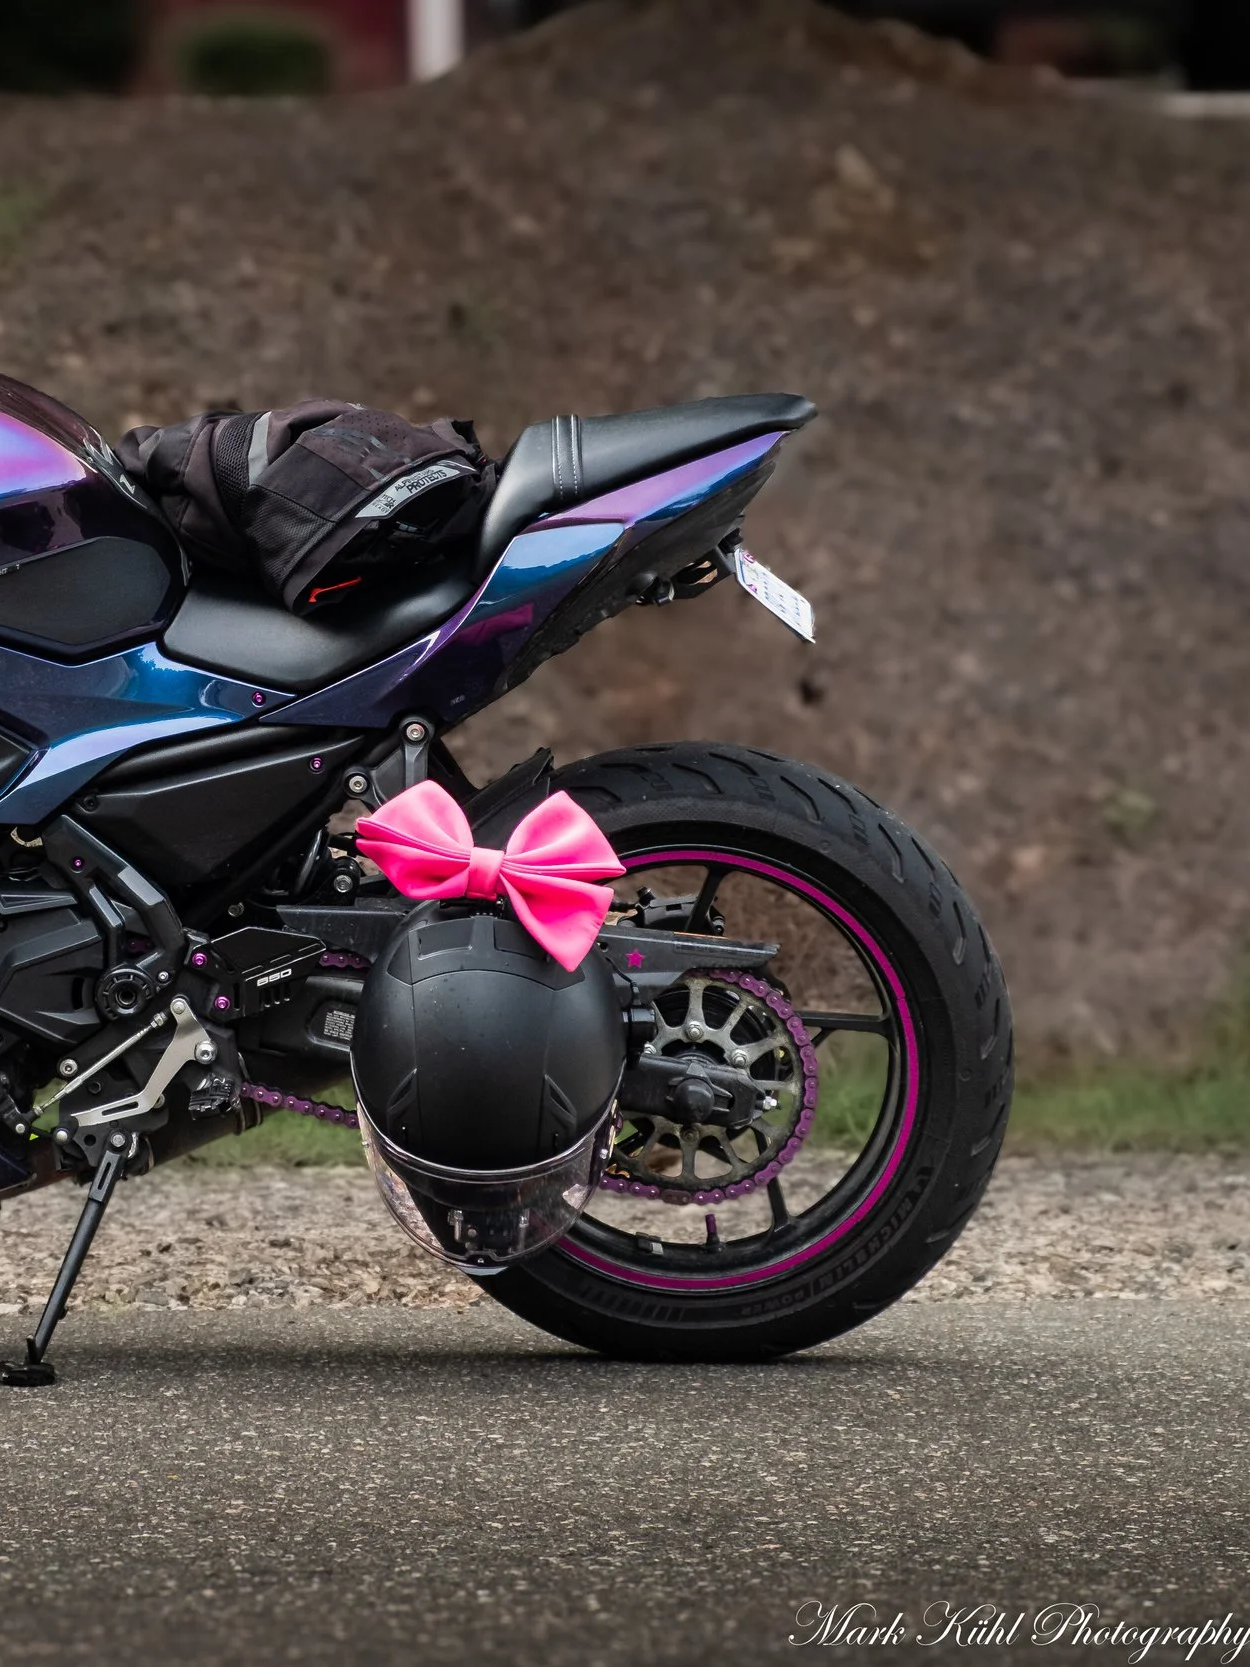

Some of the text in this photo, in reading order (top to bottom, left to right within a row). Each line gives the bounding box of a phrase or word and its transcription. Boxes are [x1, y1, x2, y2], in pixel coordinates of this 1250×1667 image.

[406, 469, 448, 494] PROTECTS
[741, 1196, 914, 1316] MICHELIN POWER
